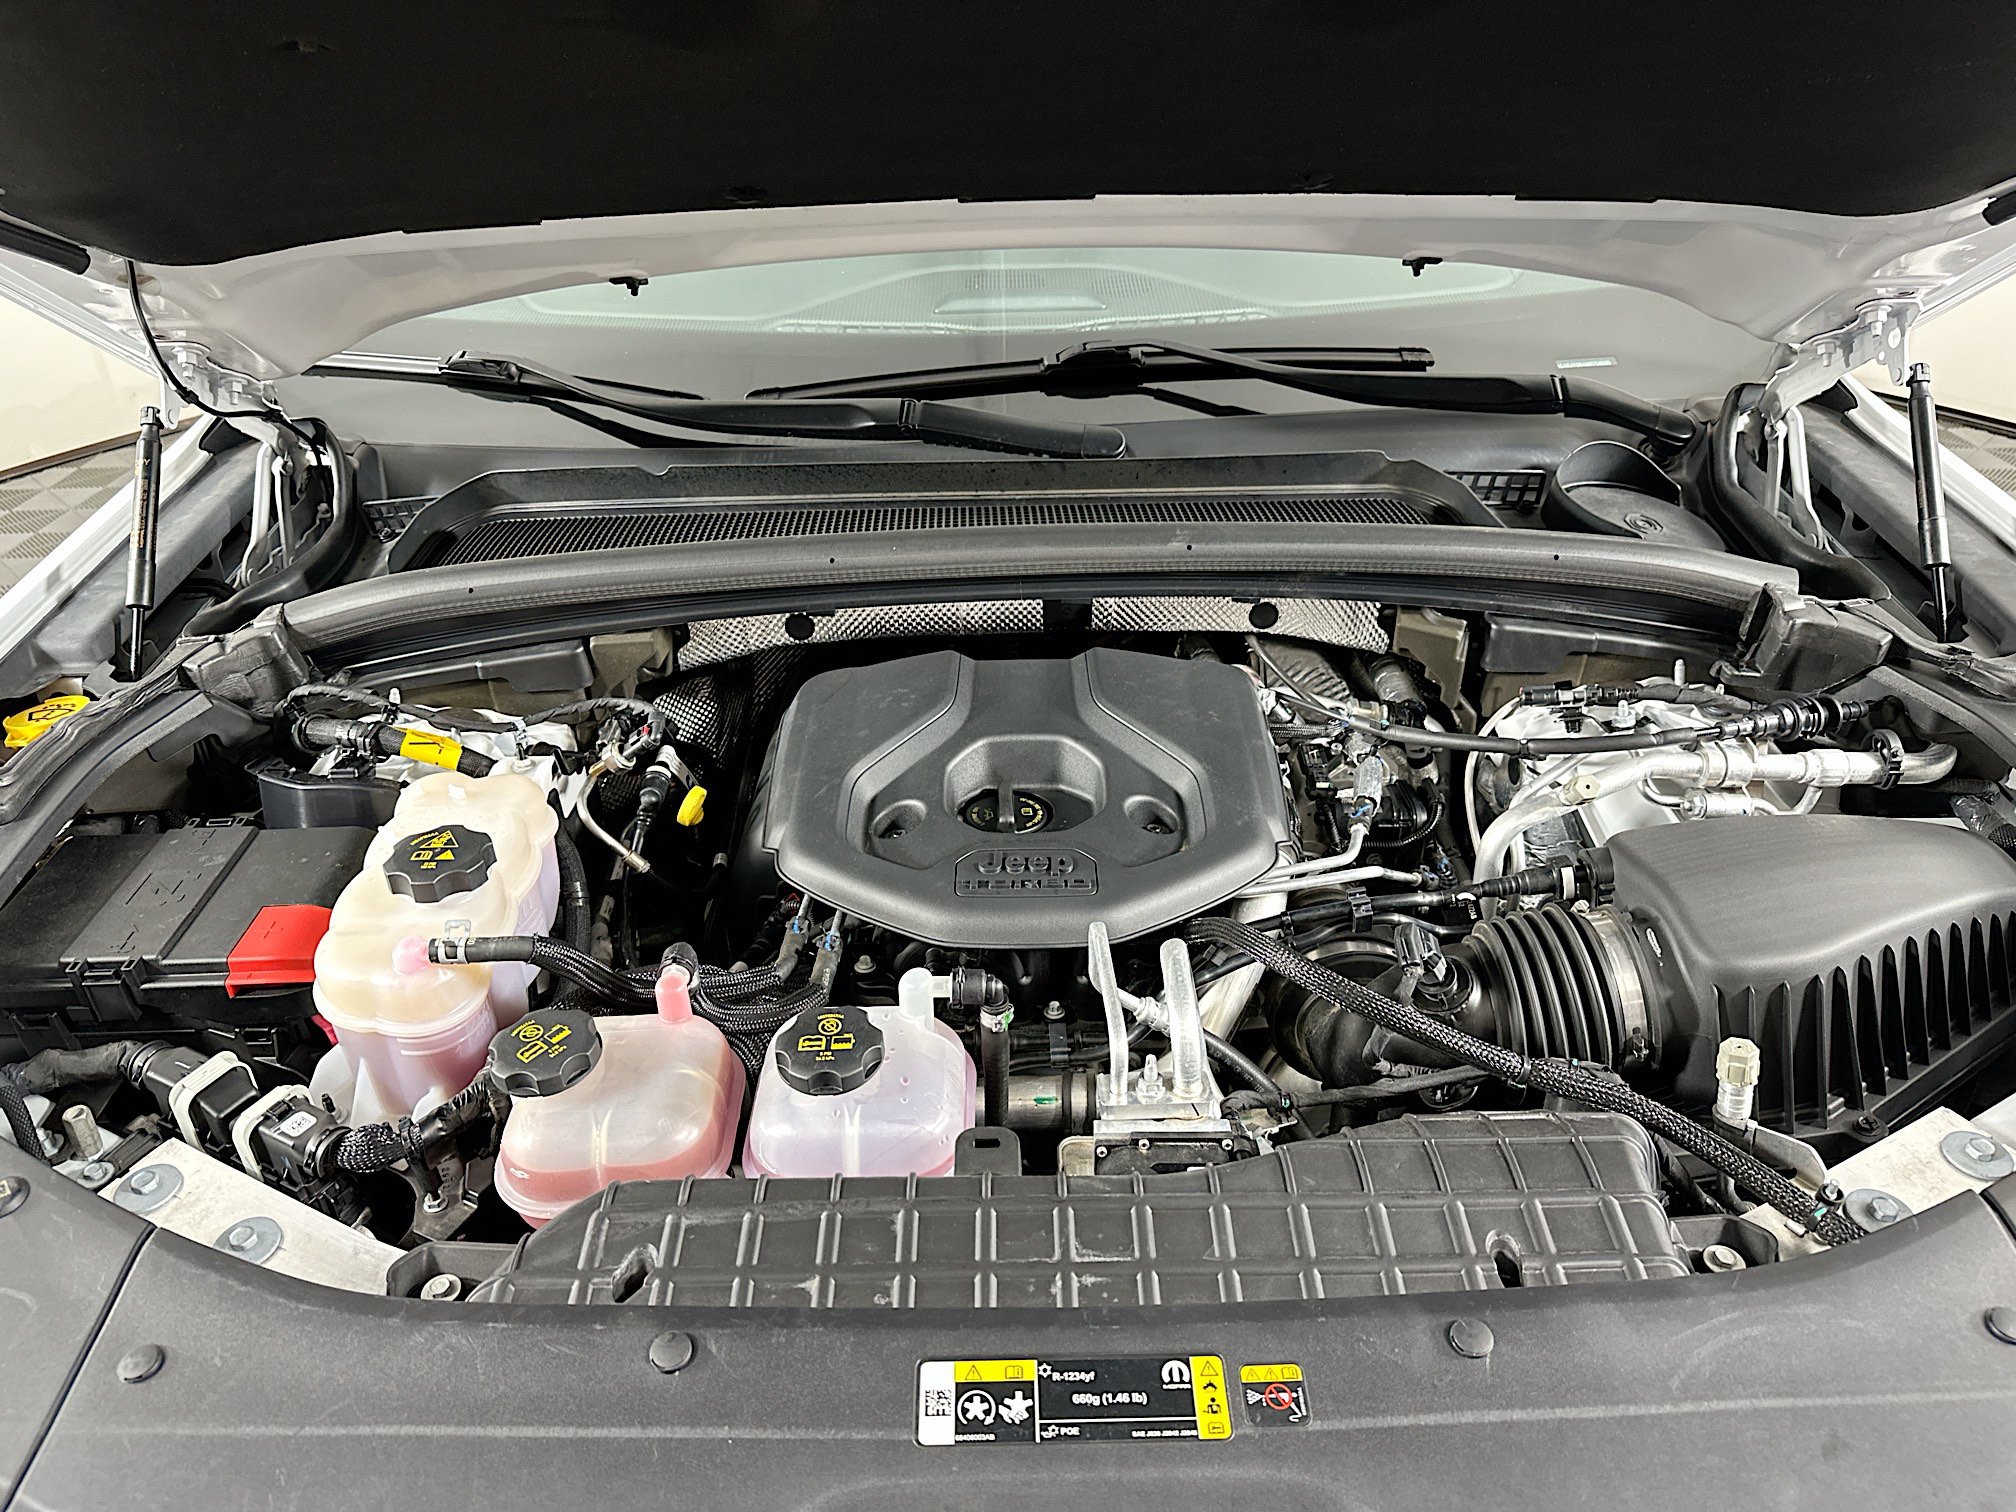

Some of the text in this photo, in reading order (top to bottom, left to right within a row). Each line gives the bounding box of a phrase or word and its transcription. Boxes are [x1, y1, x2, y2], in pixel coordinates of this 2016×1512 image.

[978, 851, 1074, 877] Jeep
[1052, 1371, 1095, 1383] R-1234yf
[1132, 1392, 1148, 1405] lb)
[1060, 1427, 1080, 1436] POE
